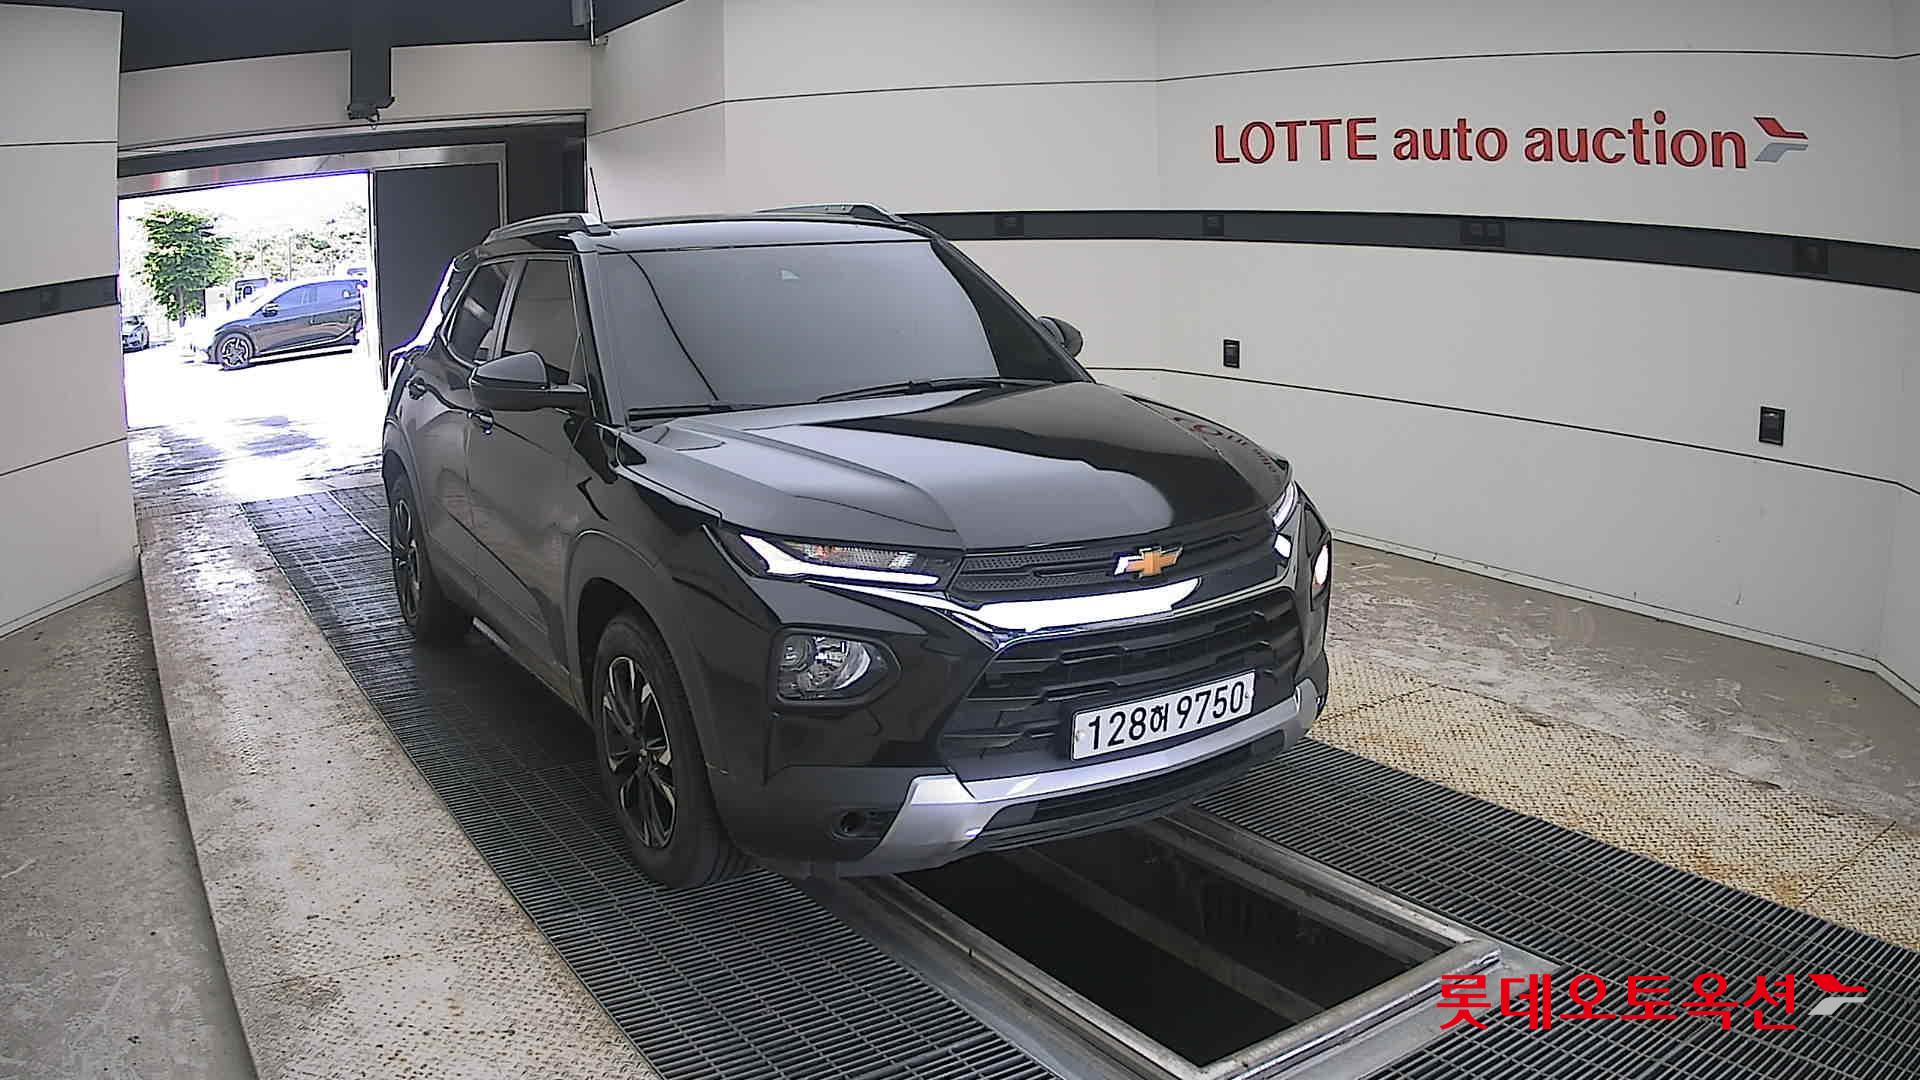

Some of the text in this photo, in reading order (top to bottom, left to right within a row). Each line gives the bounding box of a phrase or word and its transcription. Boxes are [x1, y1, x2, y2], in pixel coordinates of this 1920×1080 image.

[1215, 110, 1747, 169] LOTTE auto auction
[1176, 681, 1245, 729] 9750
